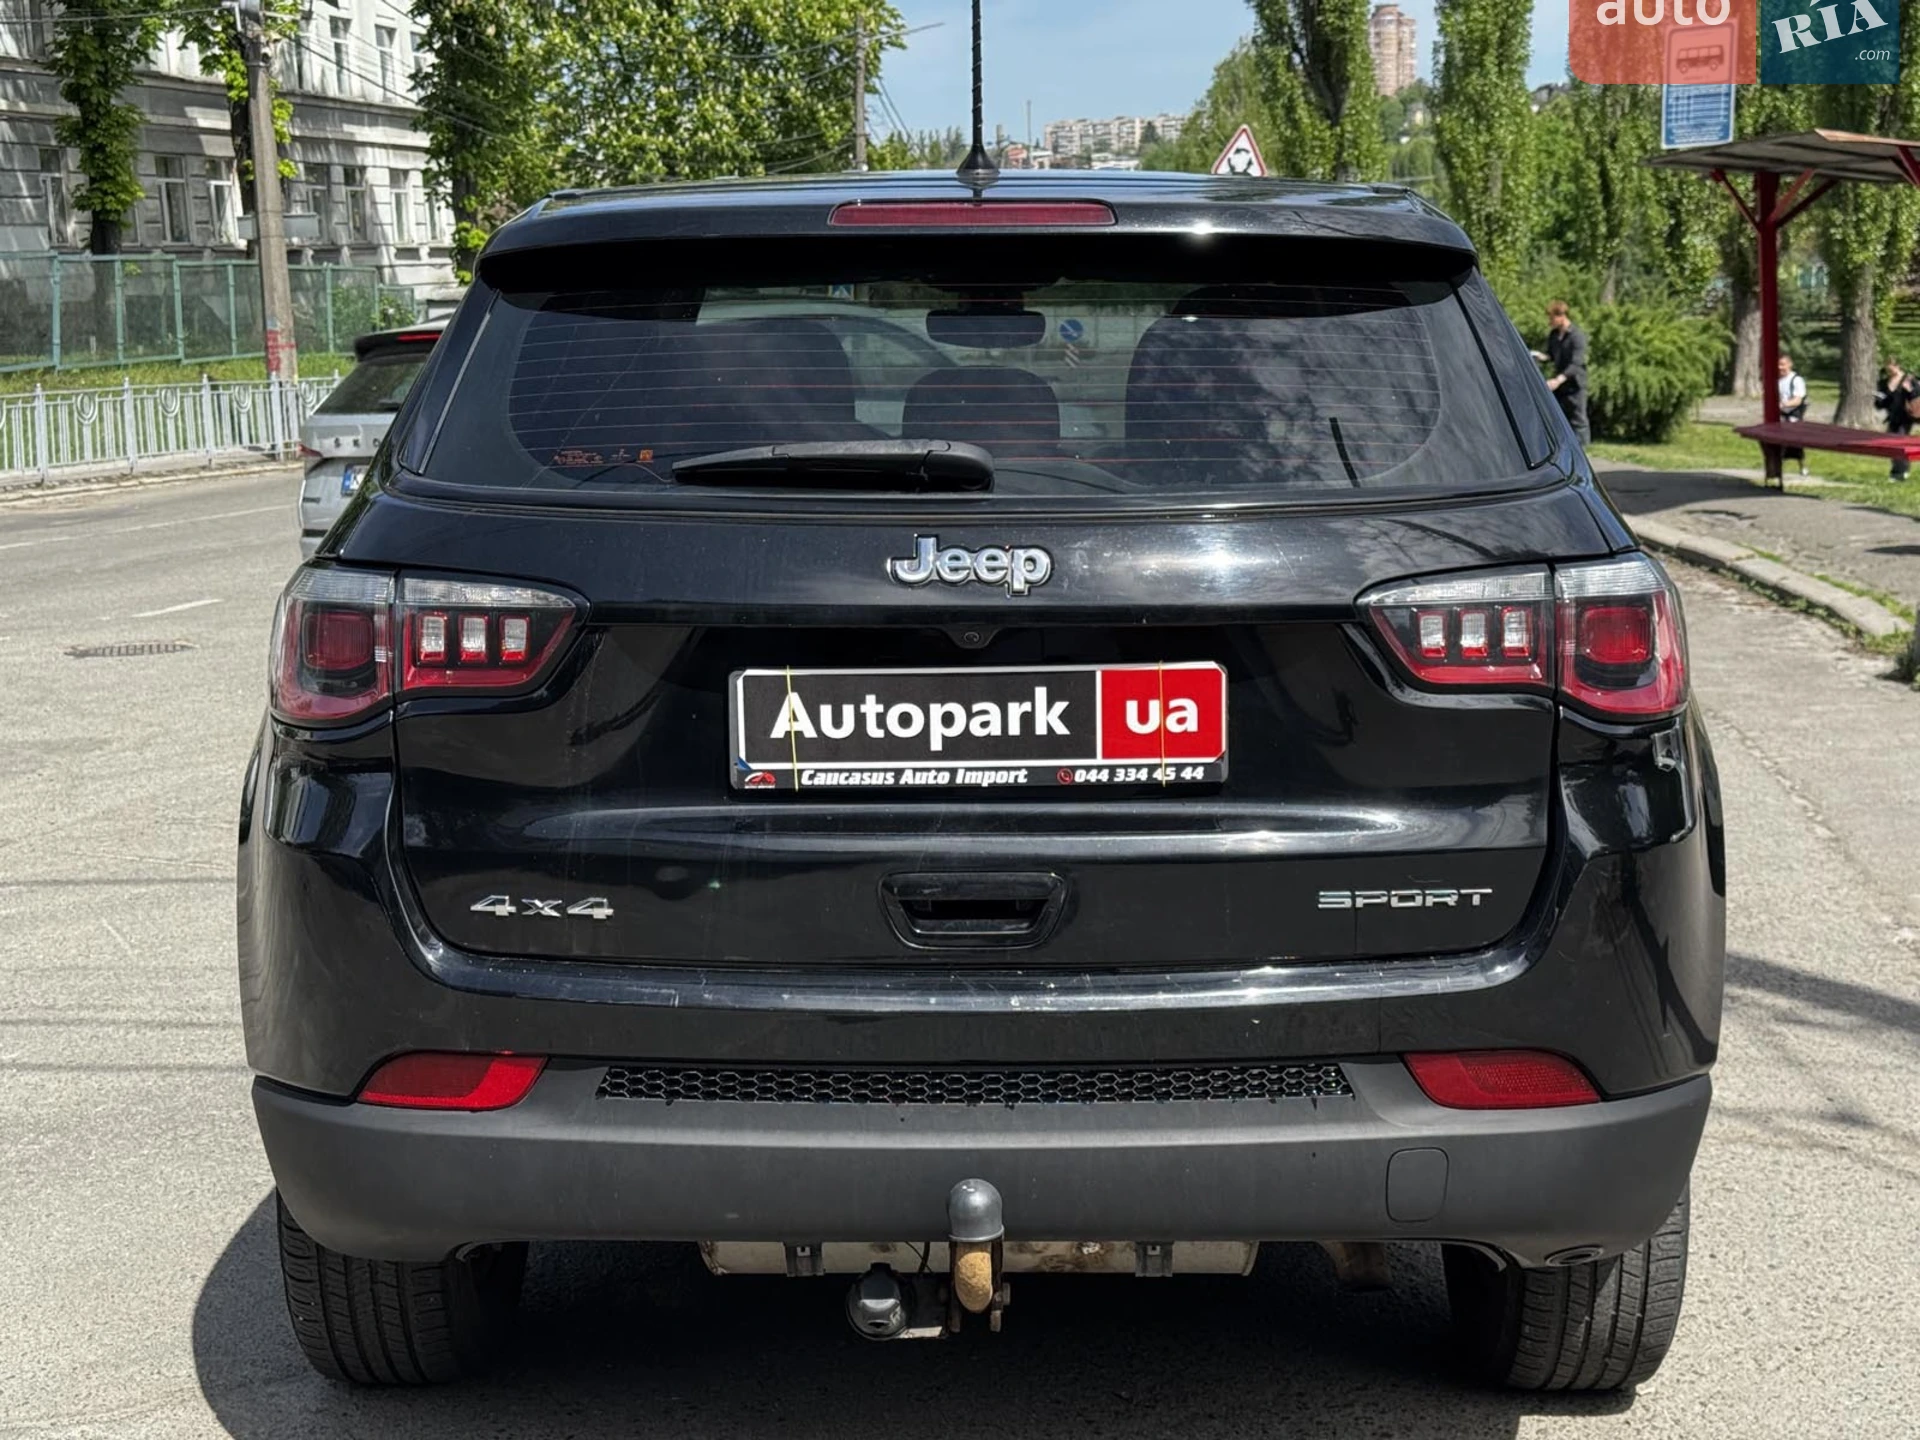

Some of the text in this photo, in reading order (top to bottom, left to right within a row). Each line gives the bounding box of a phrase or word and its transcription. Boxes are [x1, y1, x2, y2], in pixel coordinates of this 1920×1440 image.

[886, 534, 1054, 597] Jeep
[769, 686, 1199, 751] Autopark ua
[800, 768, 1028, 787] Caucasus Auto Import
[1074, 766, 1205, 783] 044 334 45 44
[1318, 888, 1493, 909] SPORT
